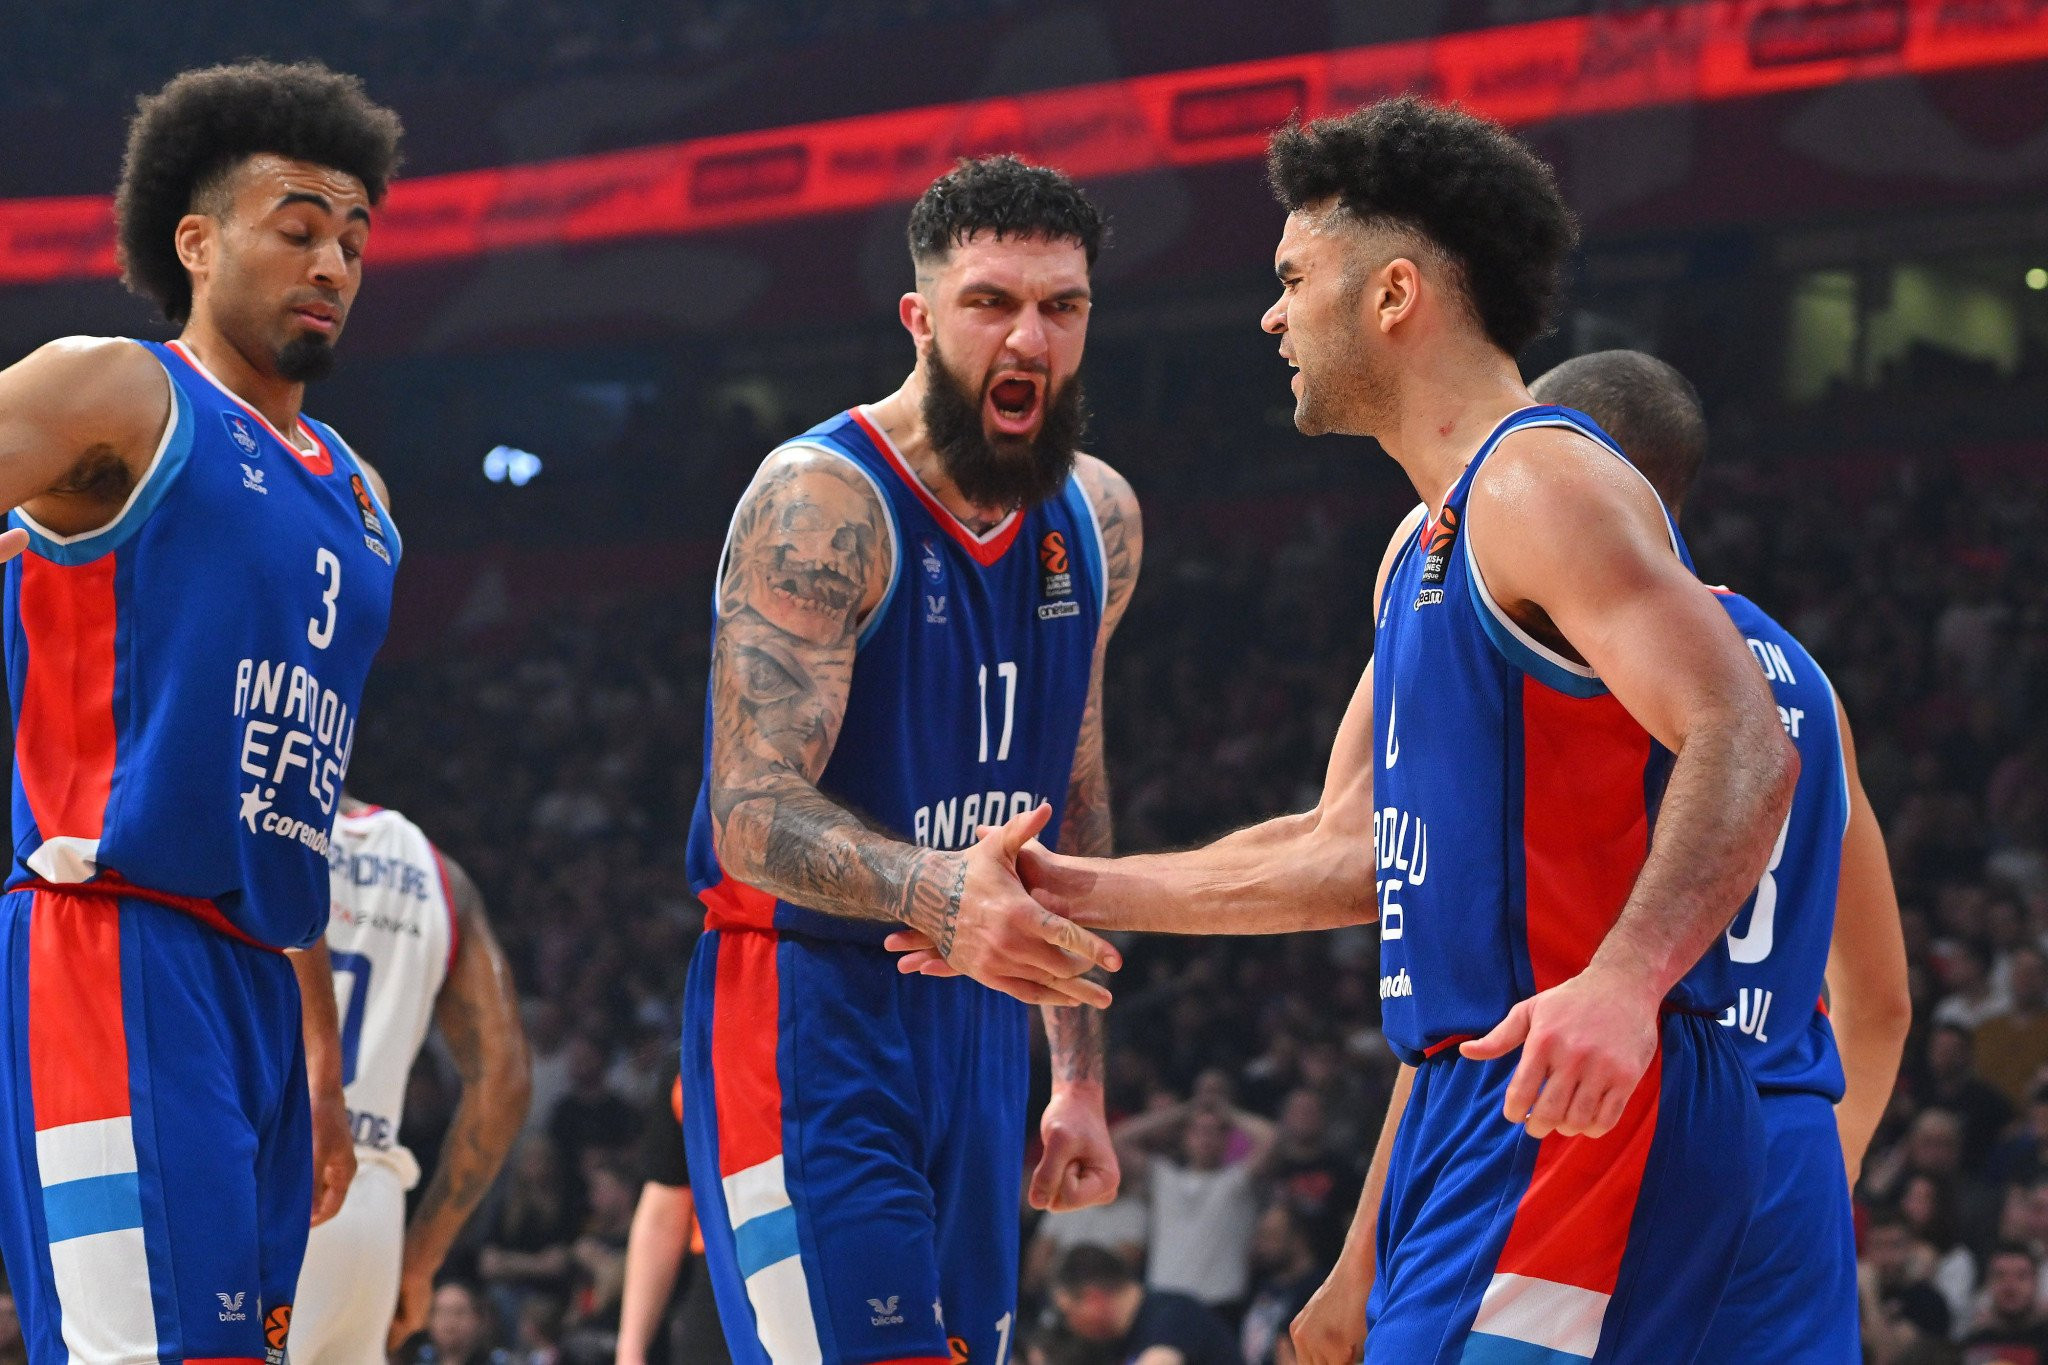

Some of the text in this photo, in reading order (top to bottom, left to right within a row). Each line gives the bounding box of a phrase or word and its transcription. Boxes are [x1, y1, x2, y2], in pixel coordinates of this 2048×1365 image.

[307, 547, 341, 650] 3
[1746, 638, 1797, 685] ON
[977, 661, 1018, 763] 17
[241, 719, 340, 815] EFES
[262, 811, 329, 856] corendo
